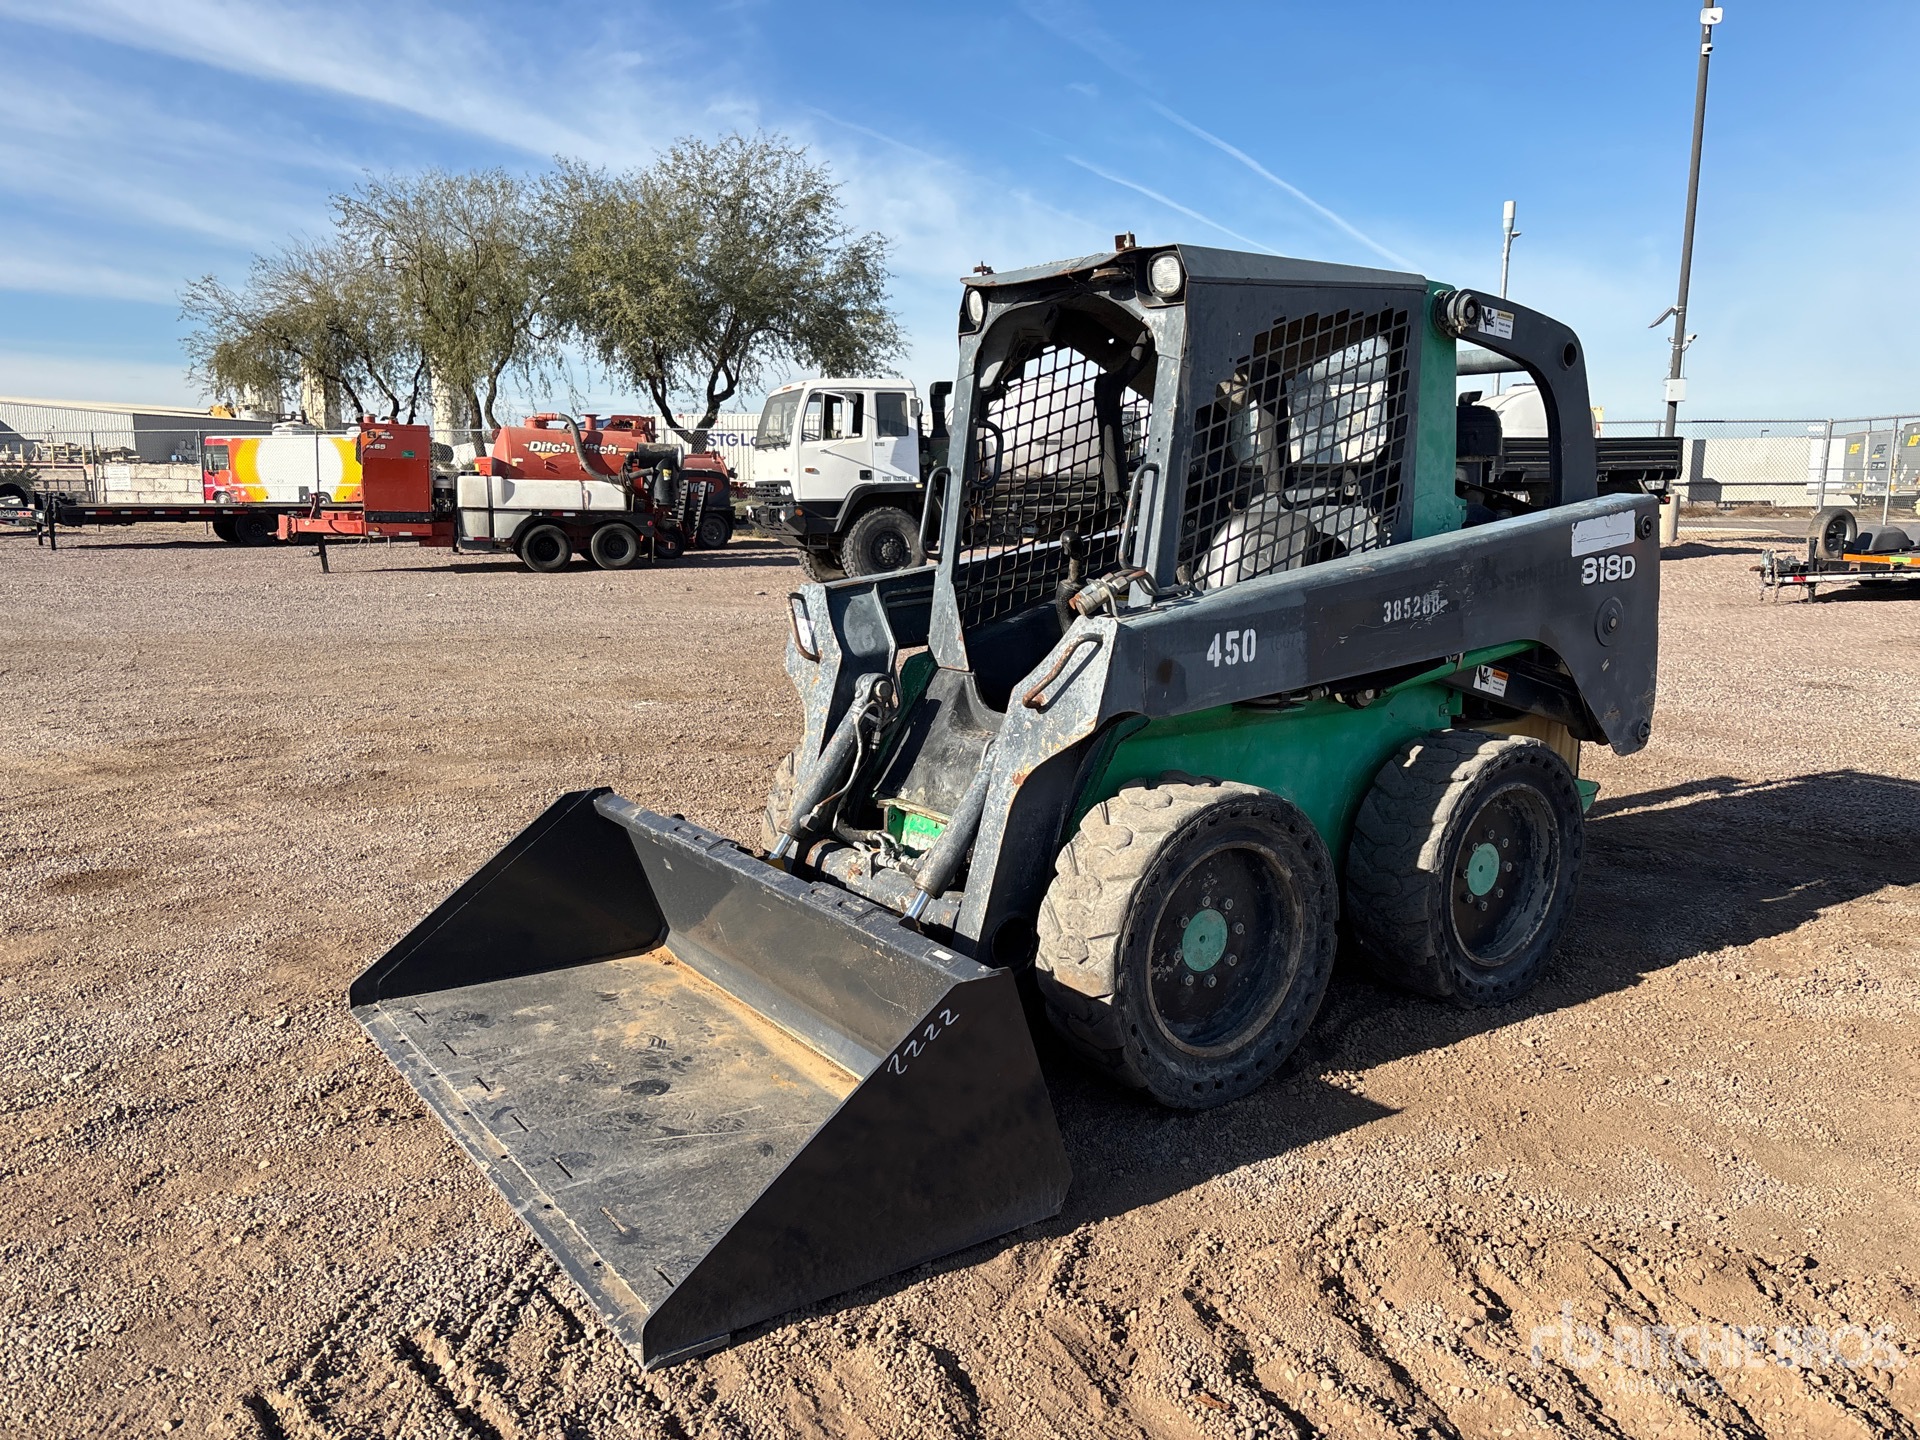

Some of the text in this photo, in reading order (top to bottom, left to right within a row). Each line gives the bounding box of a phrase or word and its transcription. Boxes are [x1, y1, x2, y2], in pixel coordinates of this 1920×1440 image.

[529, 441, 618, 454] Ditch itch
[1206, 628, 1257, 668] 450
[887, 1008, 960, 1075] 2222
